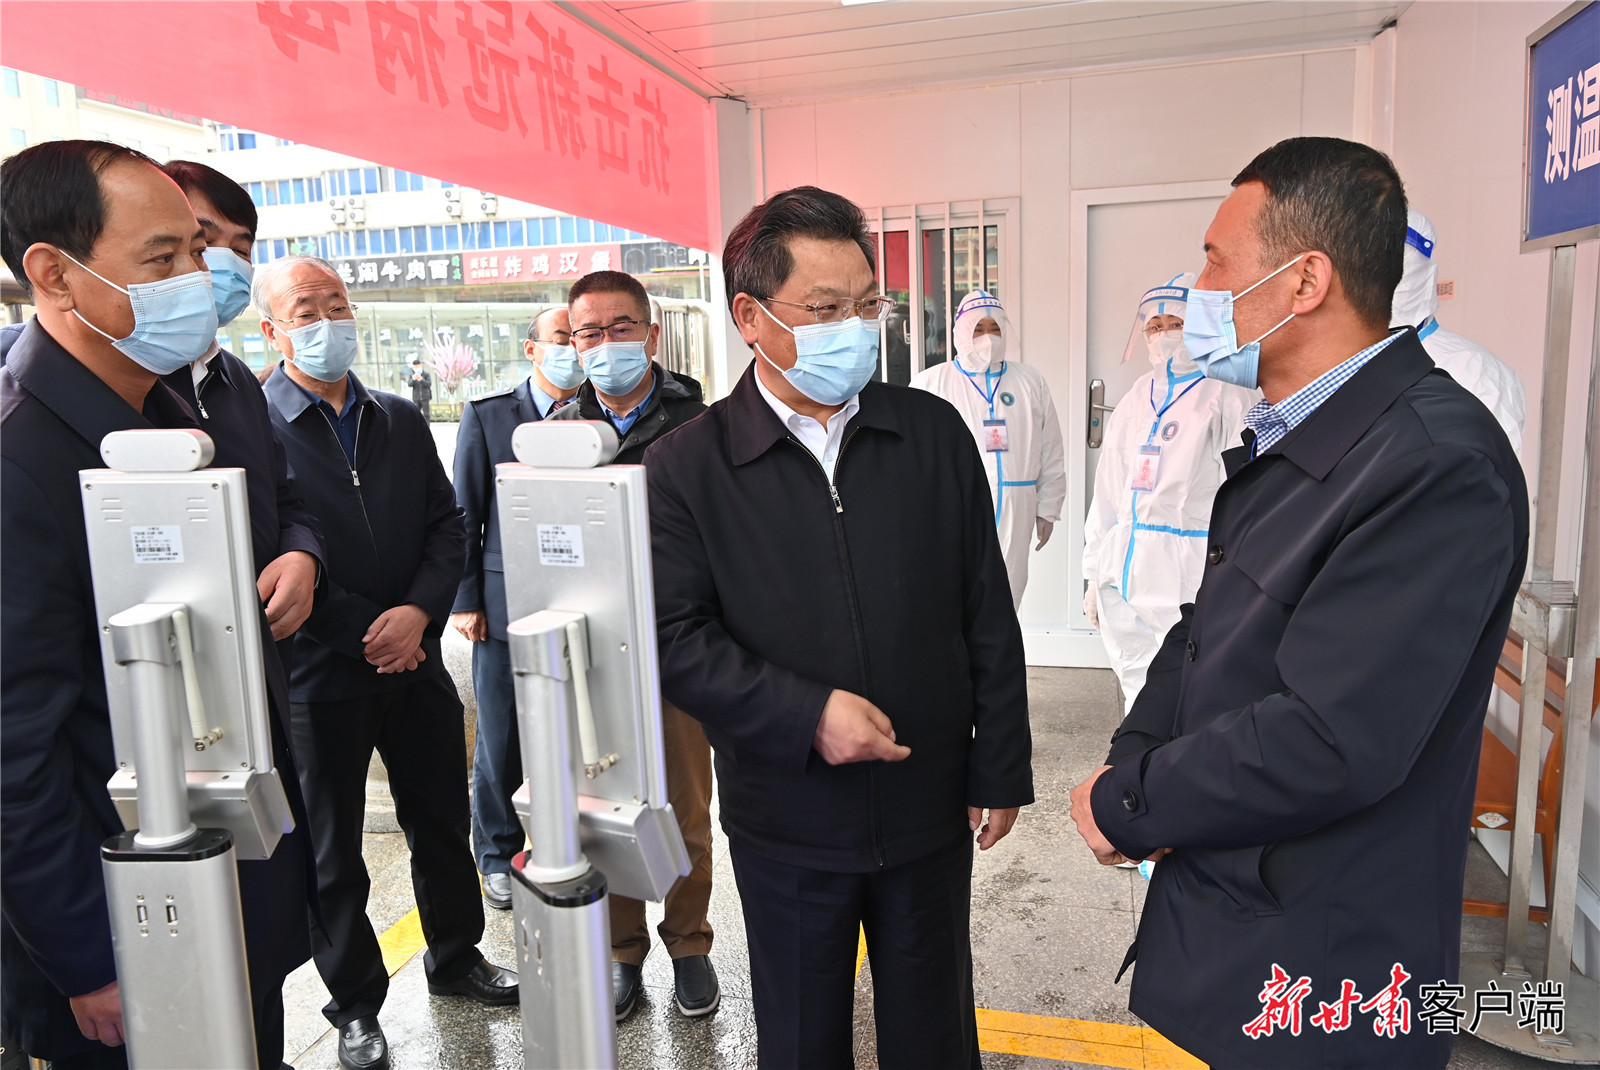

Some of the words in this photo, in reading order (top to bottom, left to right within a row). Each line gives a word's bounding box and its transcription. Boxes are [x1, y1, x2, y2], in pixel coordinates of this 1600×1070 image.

[1543, 61, 1600, 184] 测温
[504, 251, 611, 278] 炸鸡汉堡
